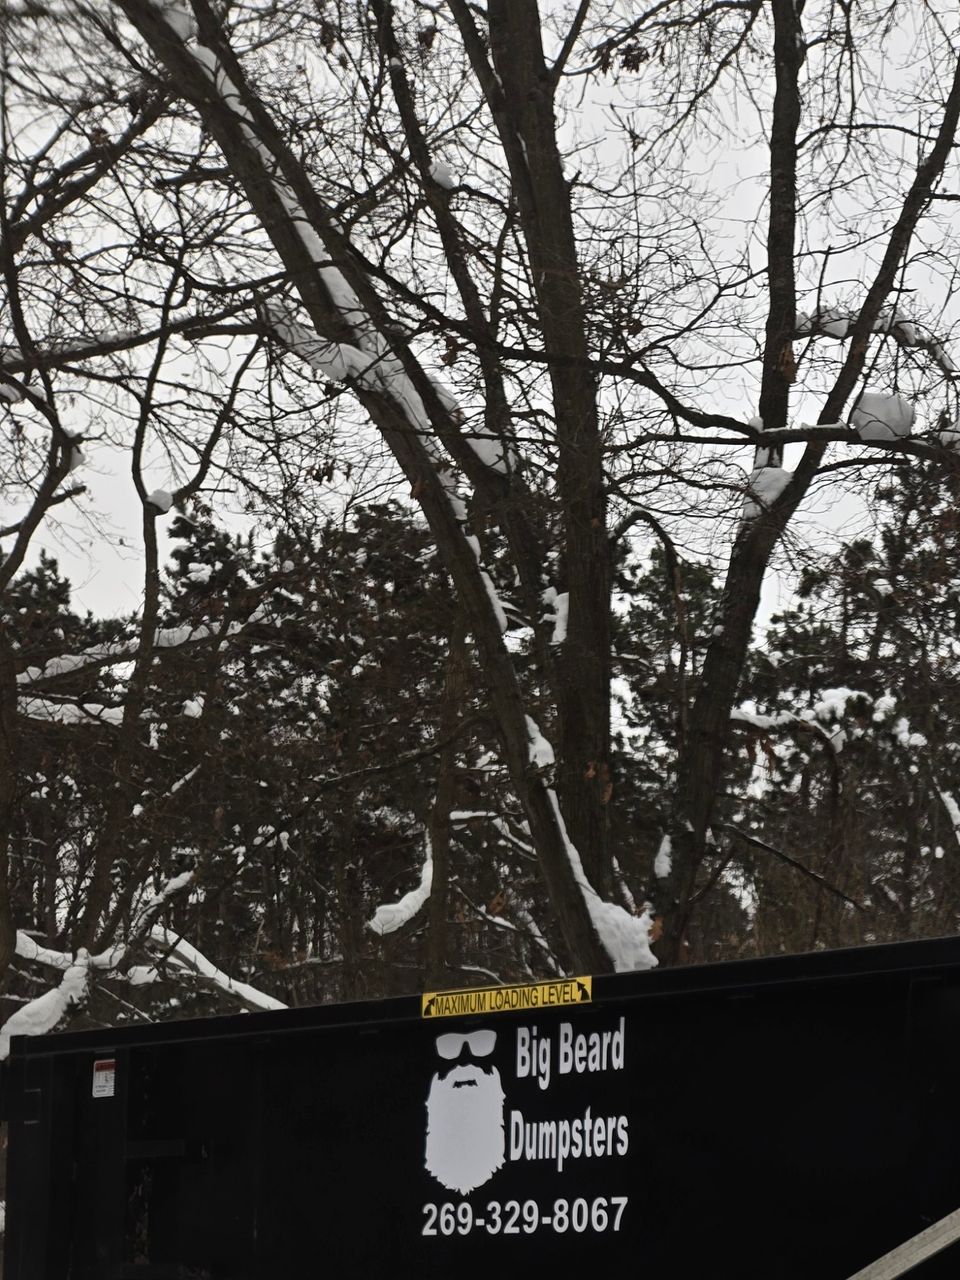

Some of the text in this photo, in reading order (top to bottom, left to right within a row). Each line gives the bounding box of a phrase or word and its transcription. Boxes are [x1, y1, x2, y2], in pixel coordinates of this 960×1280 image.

[435, 984, 577, 1015] MAXIMUM LOADING LEVEL
[516, 1016, 625, 1090] Big Beard
[510, 1105, 629, 1173] Dumpsters
[421, 1196, 629, 1236] 269-329-8067
